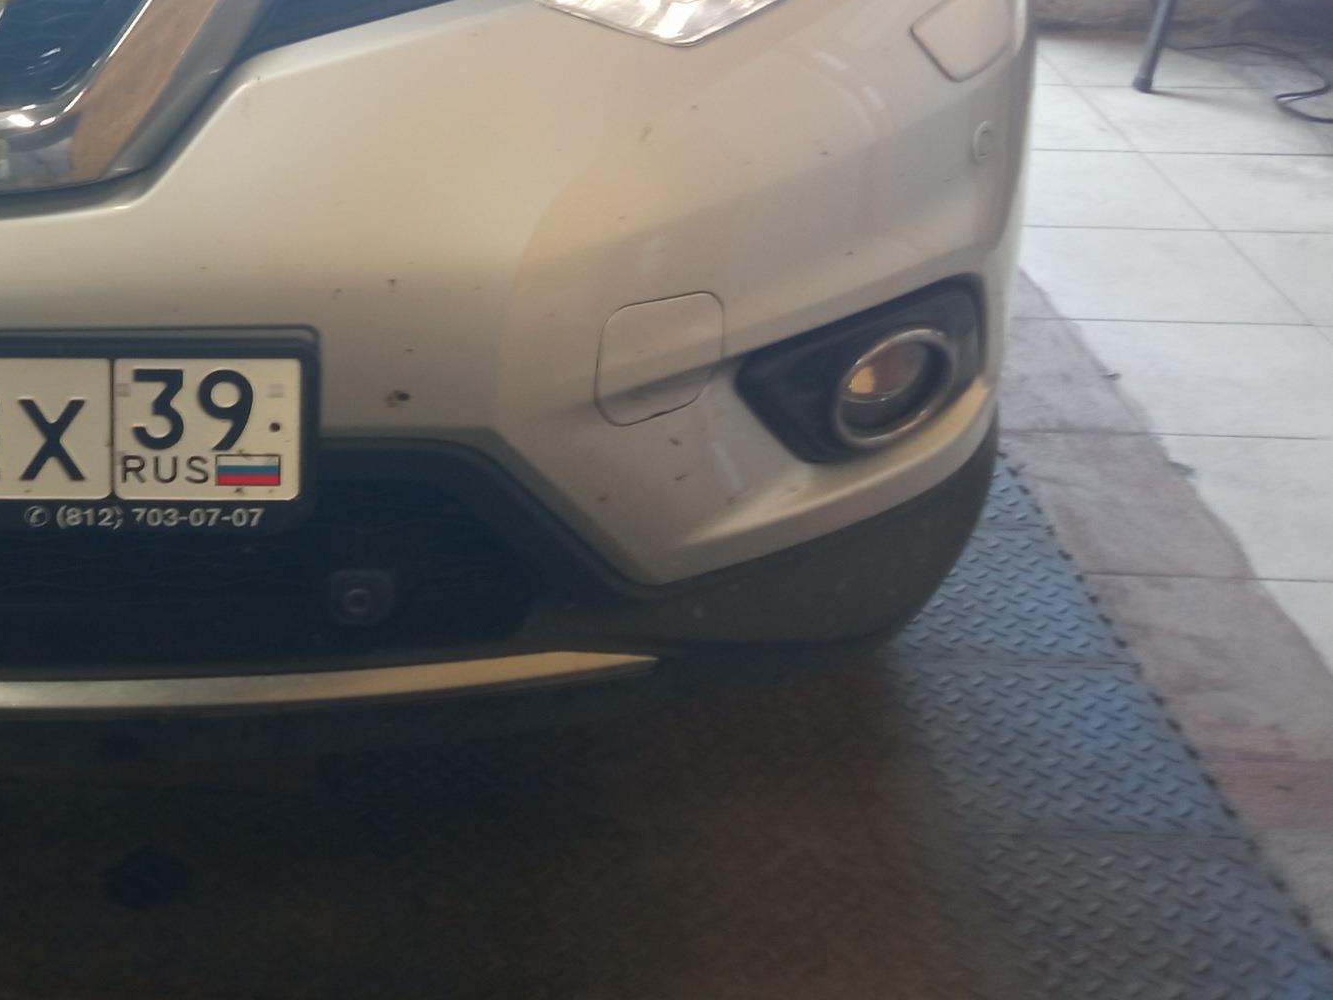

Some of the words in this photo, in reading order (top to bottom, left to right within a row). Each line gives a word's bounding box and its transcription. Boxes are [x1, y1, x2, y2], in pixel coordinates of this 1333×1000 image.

[130, 367, 255, 451] 39
[121, 455, 210, 485] RUS
[56, 504, 124, 530] (812)
[131, 507, 265, 527] 703-07-07
